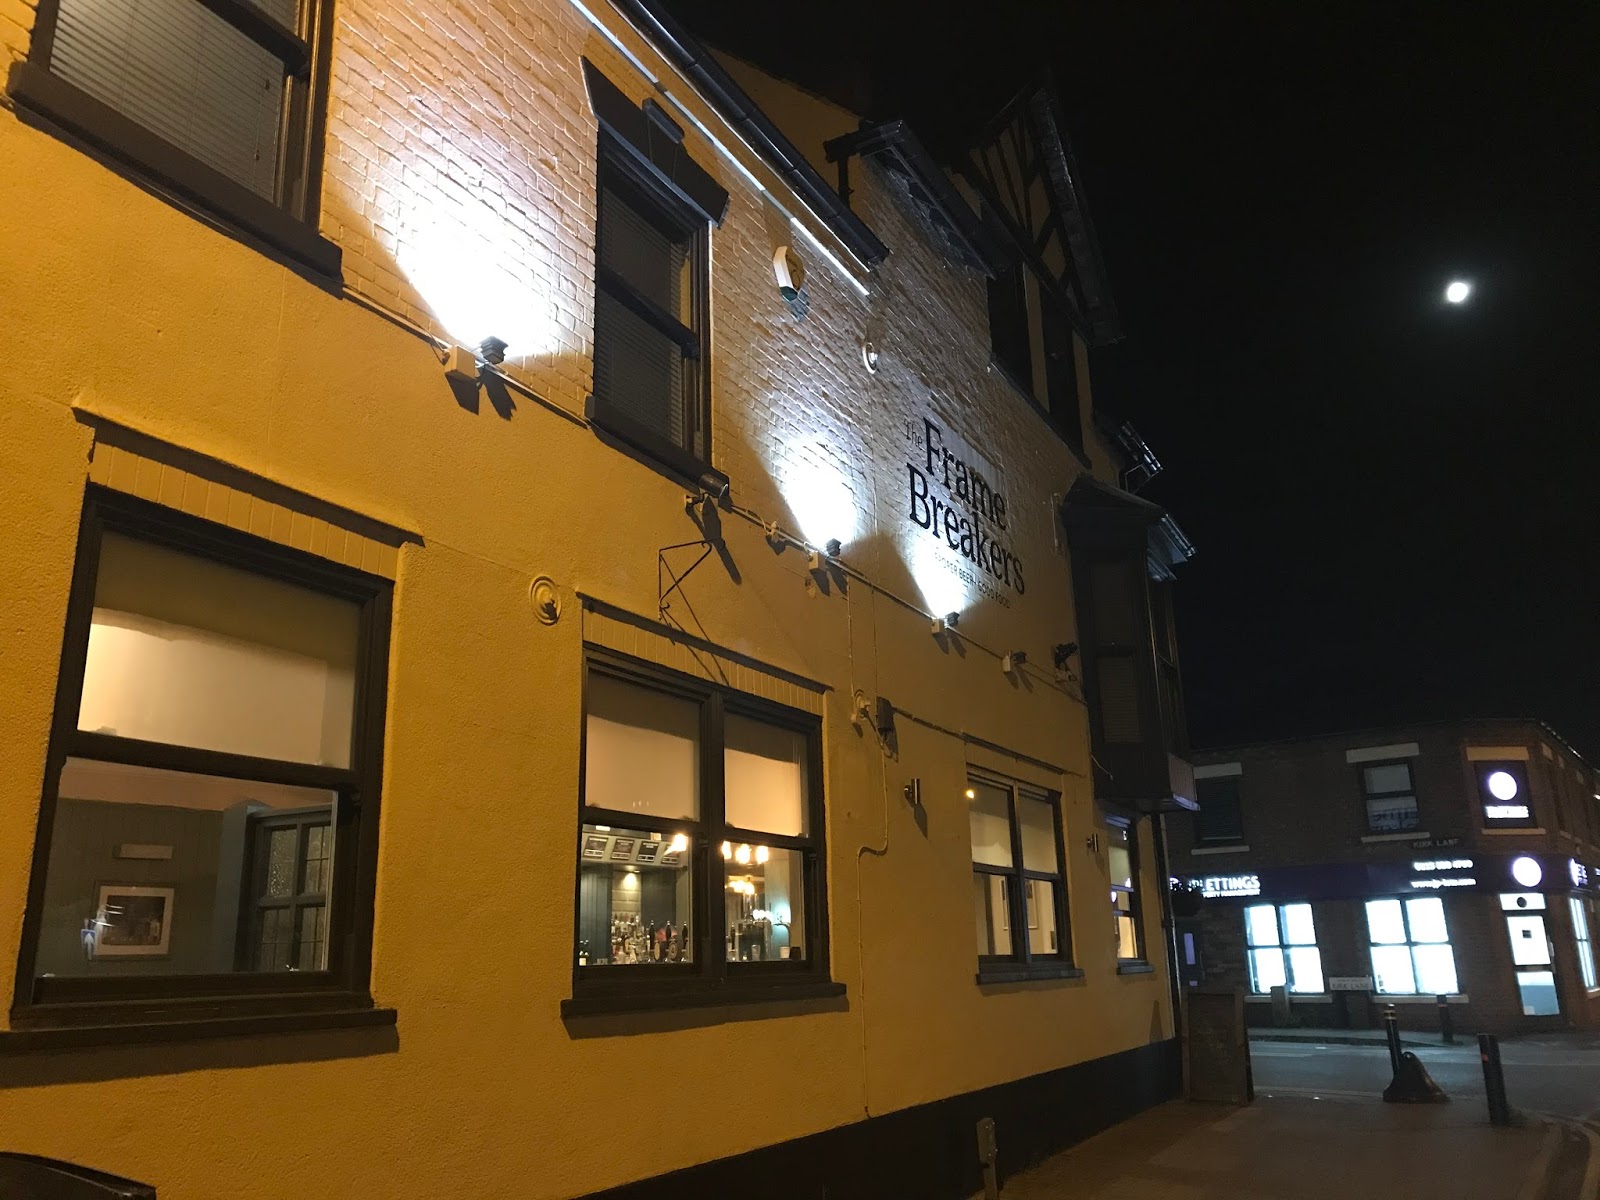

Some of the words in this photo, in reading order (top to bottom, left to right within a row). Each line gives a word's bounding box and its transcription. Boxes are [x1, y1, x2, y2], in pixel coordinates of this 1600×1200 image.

[904, 418, 922, 448] The
[923, 417, 1007, 531] Frame
[906, 462, 1025, 596] Breakers
